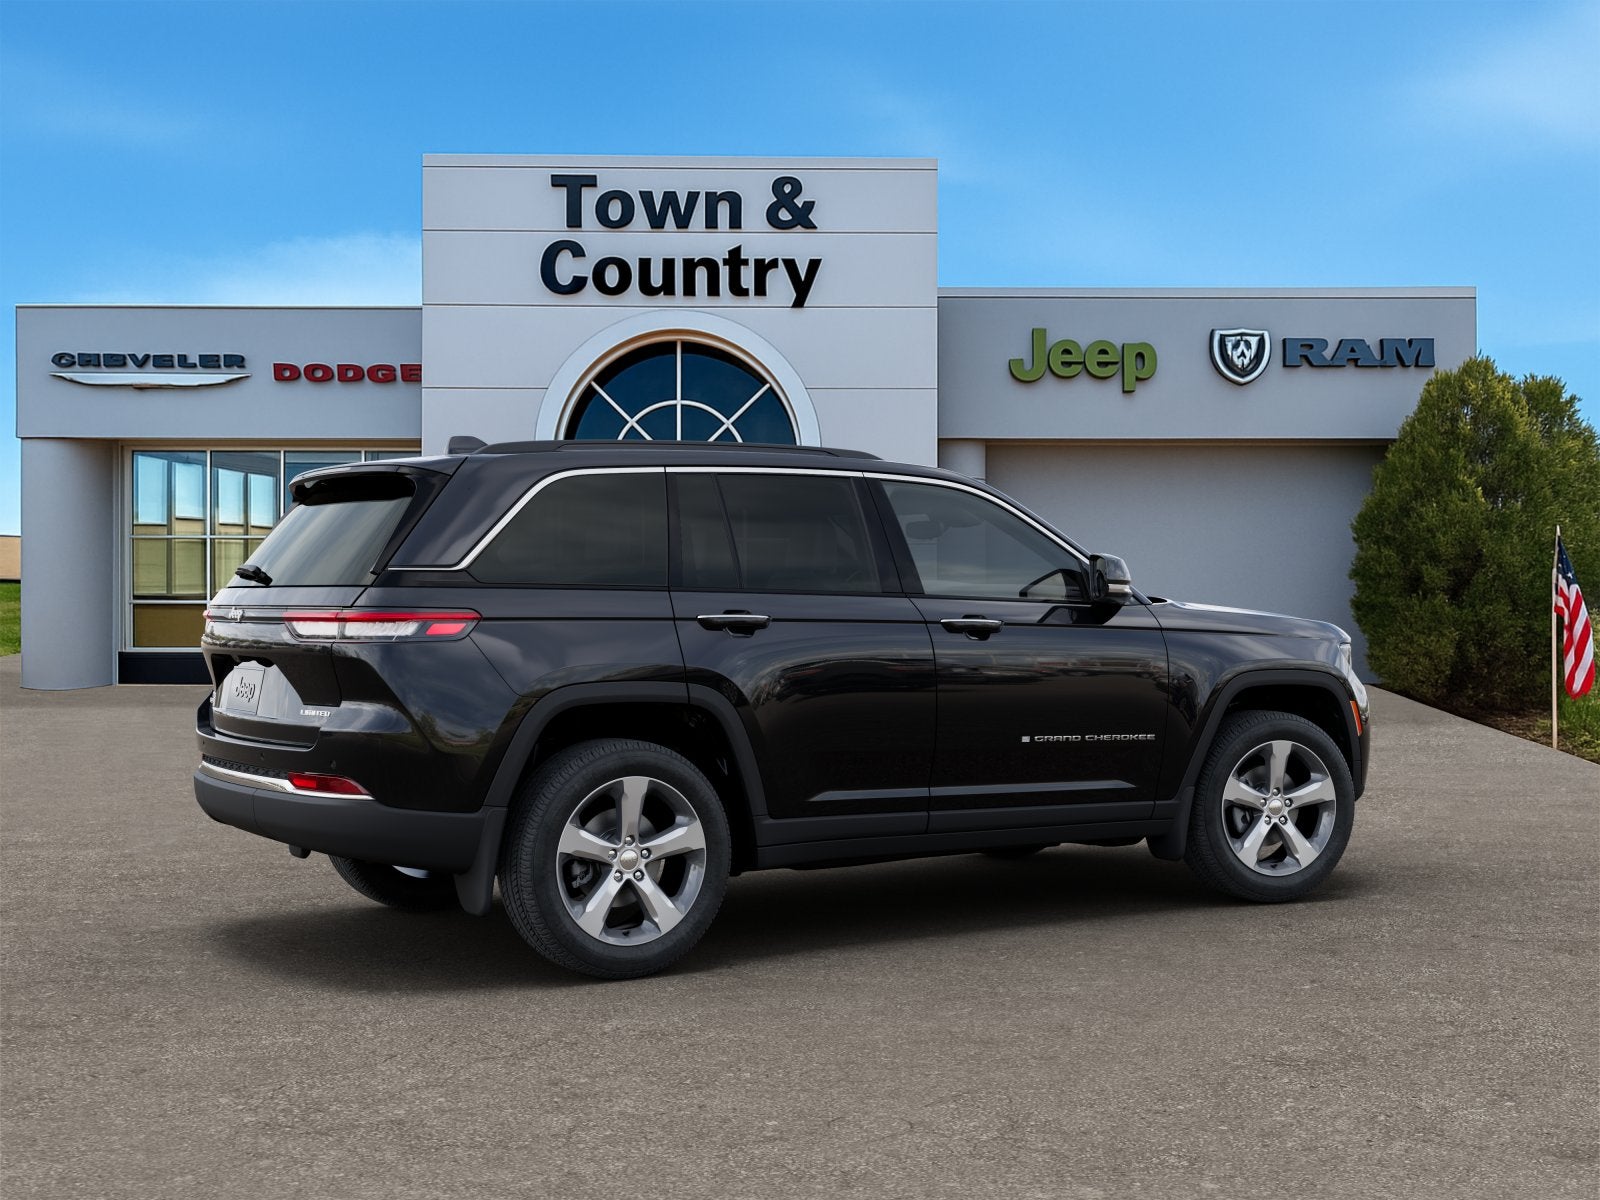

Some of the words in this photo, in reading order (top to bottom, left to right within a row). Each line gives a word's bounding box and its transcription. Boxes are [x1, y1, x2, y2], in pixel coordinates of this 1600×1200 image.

[550, 174, 742, 229] Town
[766, 176, 817, 229] &
[540, 239, 822, 308] Country
[273, 363, 422, 383] DODGE
[1009, 328, 1157, 393] Jeep
[1283, 337, 1436, 367] RAM
